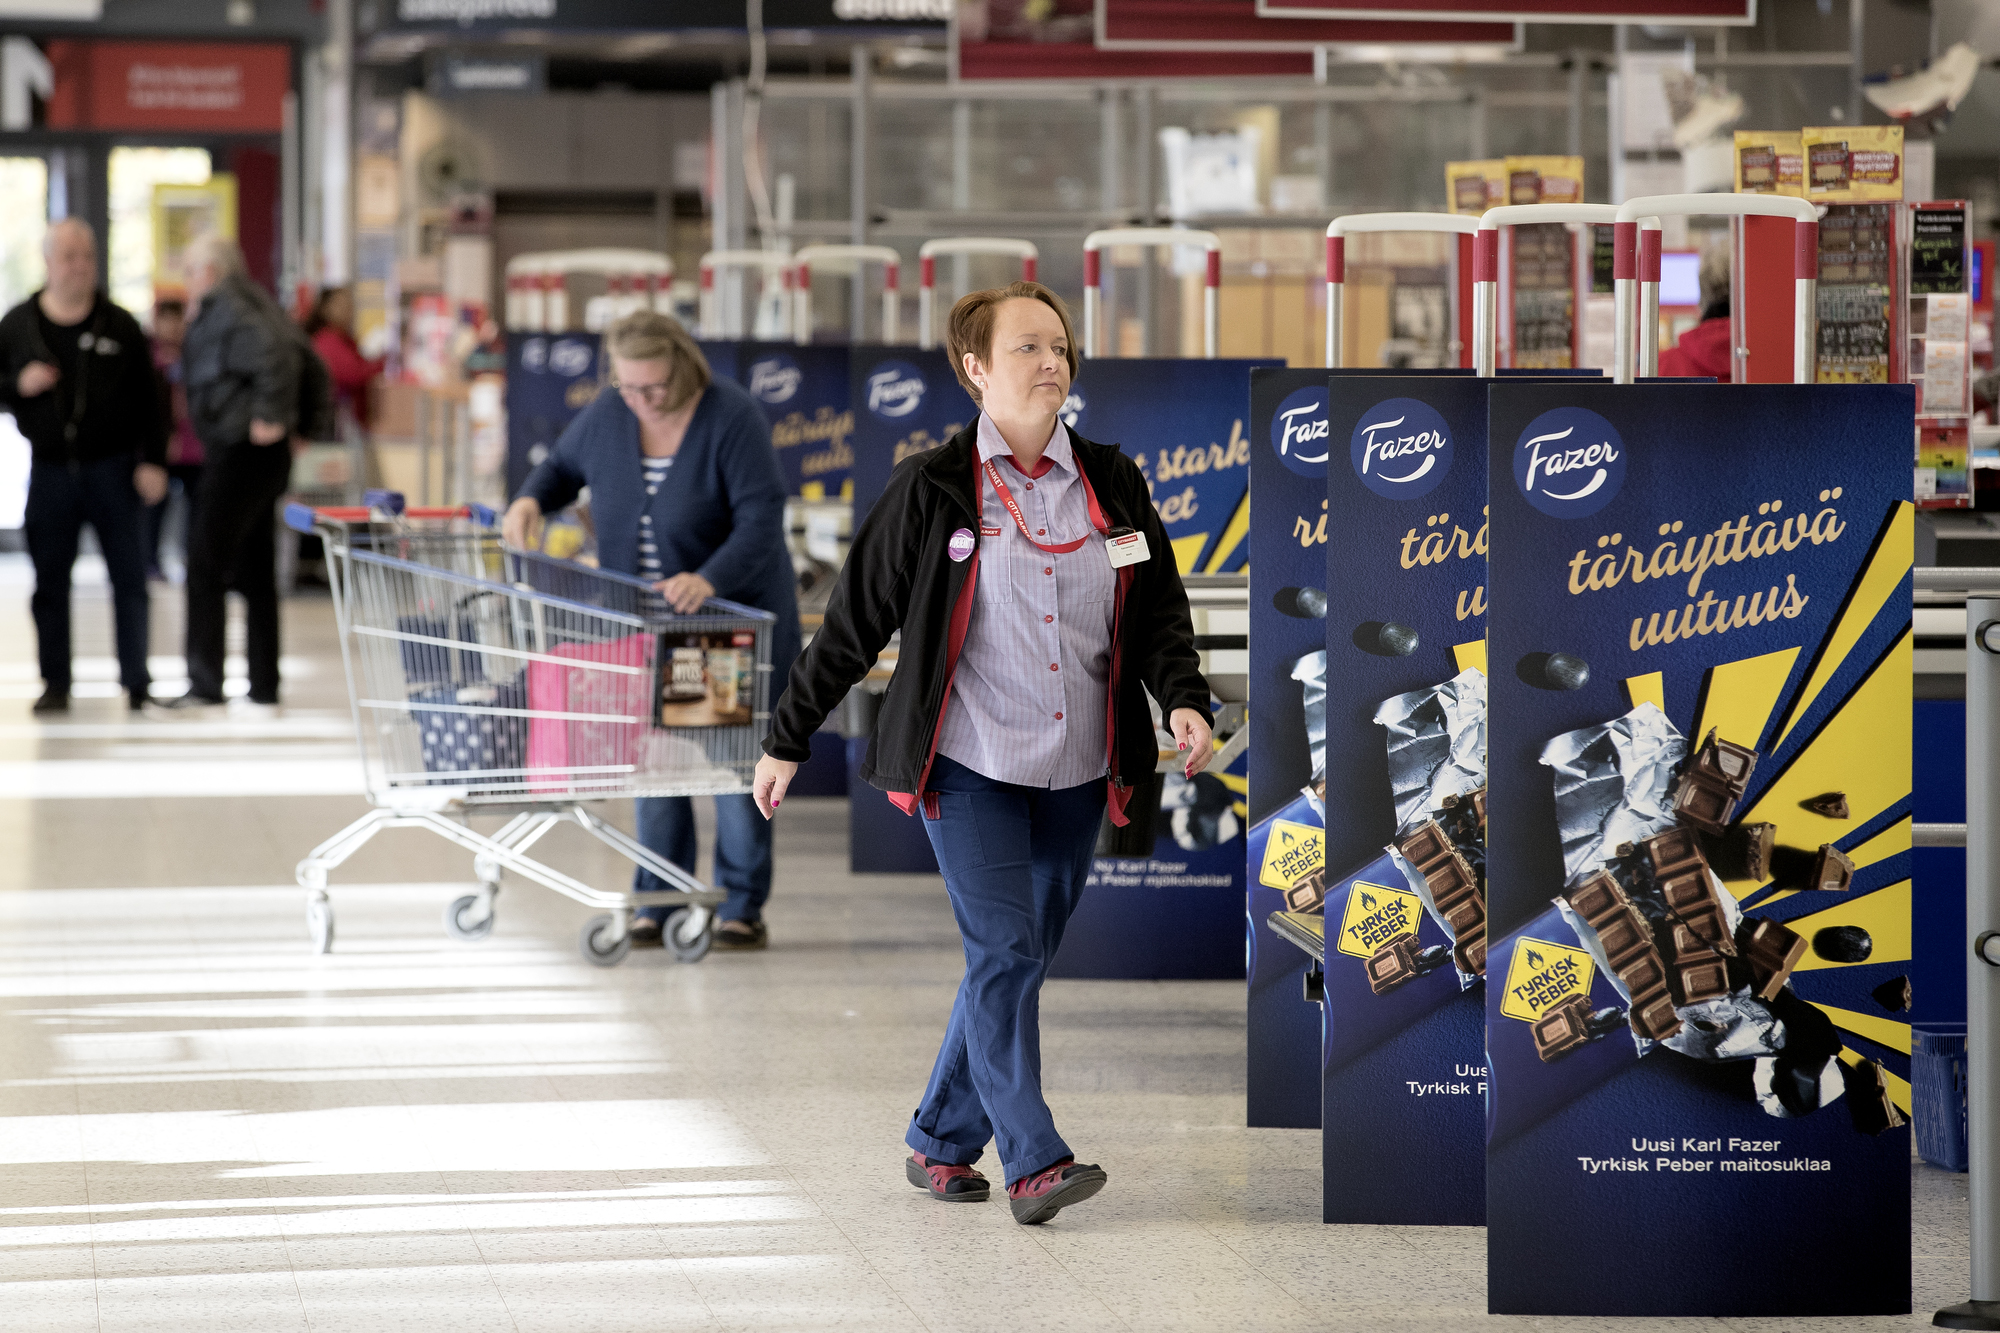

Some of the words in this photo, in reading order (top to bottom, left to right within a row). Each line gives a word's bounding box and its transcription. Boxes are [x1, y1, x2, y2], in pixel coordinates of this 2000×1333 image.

[1156, 418, 1250, 483] stark
[1361, 415, 1447, 475] Fazer
[1525, 426, 1619, 492] Fazer
[1567, 486, 1847, 598] täräyttävä
[1629, 573, 1809, 652] uutuus
[1101, 874, 1142, 887] Peber
[1117, 860, 1146, 873] Karl
[1148, 860, 1188, 873] Fazer
[1361, 914, 1410, 950] PEBER
[1527, 973, 1581, 1012] PEBER
[1406, 1081, 1471, 1097] Tyrkisk
[1631, 1137, 1675, 1152] Uusi
[1682, 1137, 1722, 1152] Karl
[1728, 1137, 1781, 1152] Fazer
[1577, 1156, 1649, 1174] Tyrkisk
[1656, 1157, 1714, 1172] Peber
[1720, 1157, 1831, 1172] maitosuklaa
